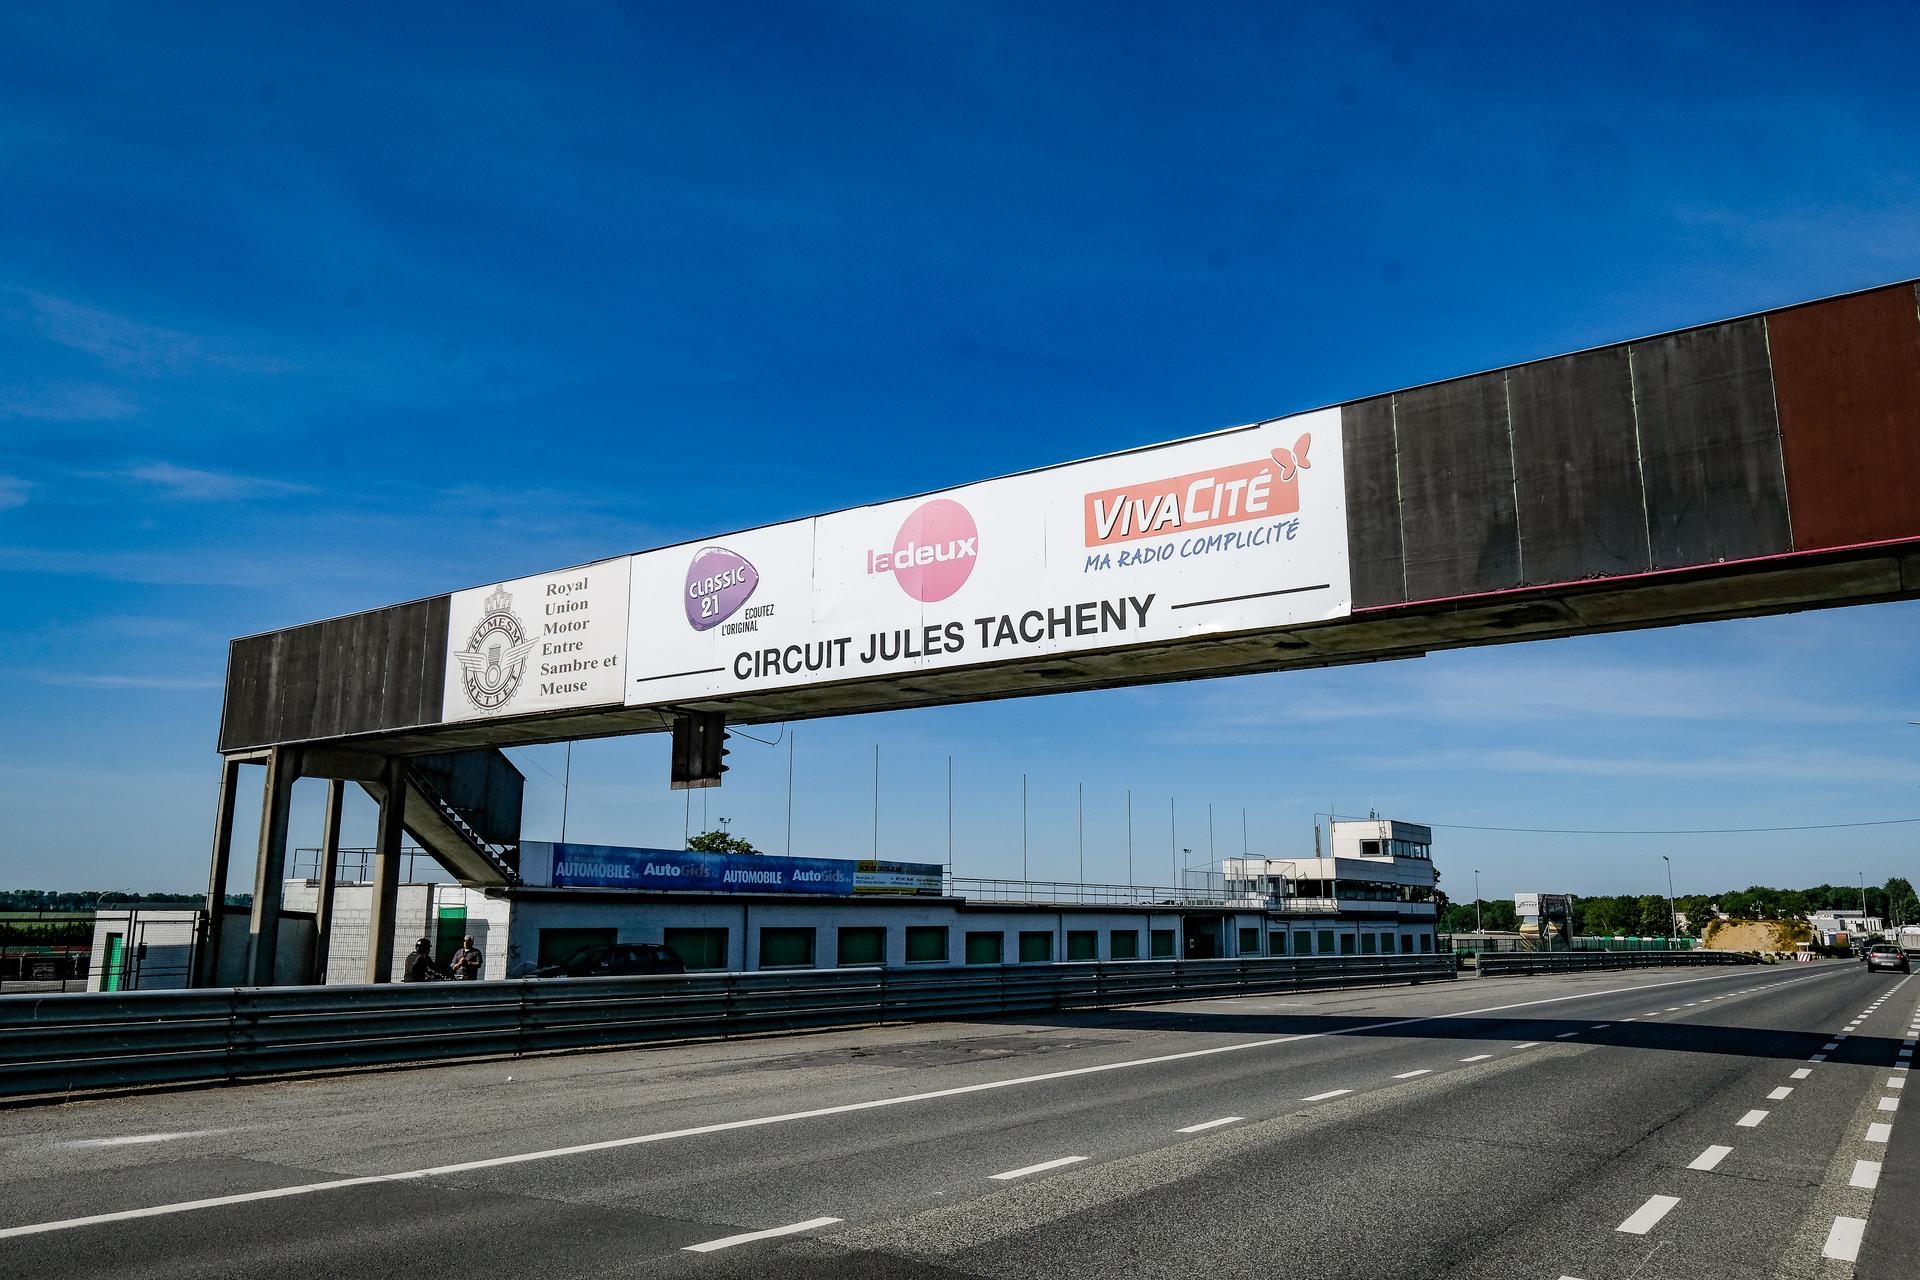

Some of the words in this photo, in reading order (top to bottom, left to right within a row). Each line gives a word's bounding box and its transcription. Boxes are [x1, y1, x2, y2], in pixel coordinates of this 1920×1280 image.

[1084, 553, 1111, 573] MA
[1117, 543, 1175, 568] RADIO
[1180, 518, 1300, 558] COMPLICITÉ
[546, 577, 588, 596] Royal
[689, 565, 746, 599] CLASSIC
[545, 600, 588, 616] Union
[701, 594, 720, 619] 21
[745, 604, 775, 620] ECOUTEZ
[543, 620, 590, 636] Motor
[721, 620, 759, 636] L'ORIGINAL
[733, 637, 852, 680] CIRCUIT
[860, 621, 965, 663] JULES
[974, 593, 1156, 648] TACHENY
[541, 640, 583, 656] Entre
[540, 659, 599, 676] Sambre
[603, 654, 618, 667] et
[540, 681, 588, 696] Meuse
[723, 870, 782, 885] AUTOMOBILE
